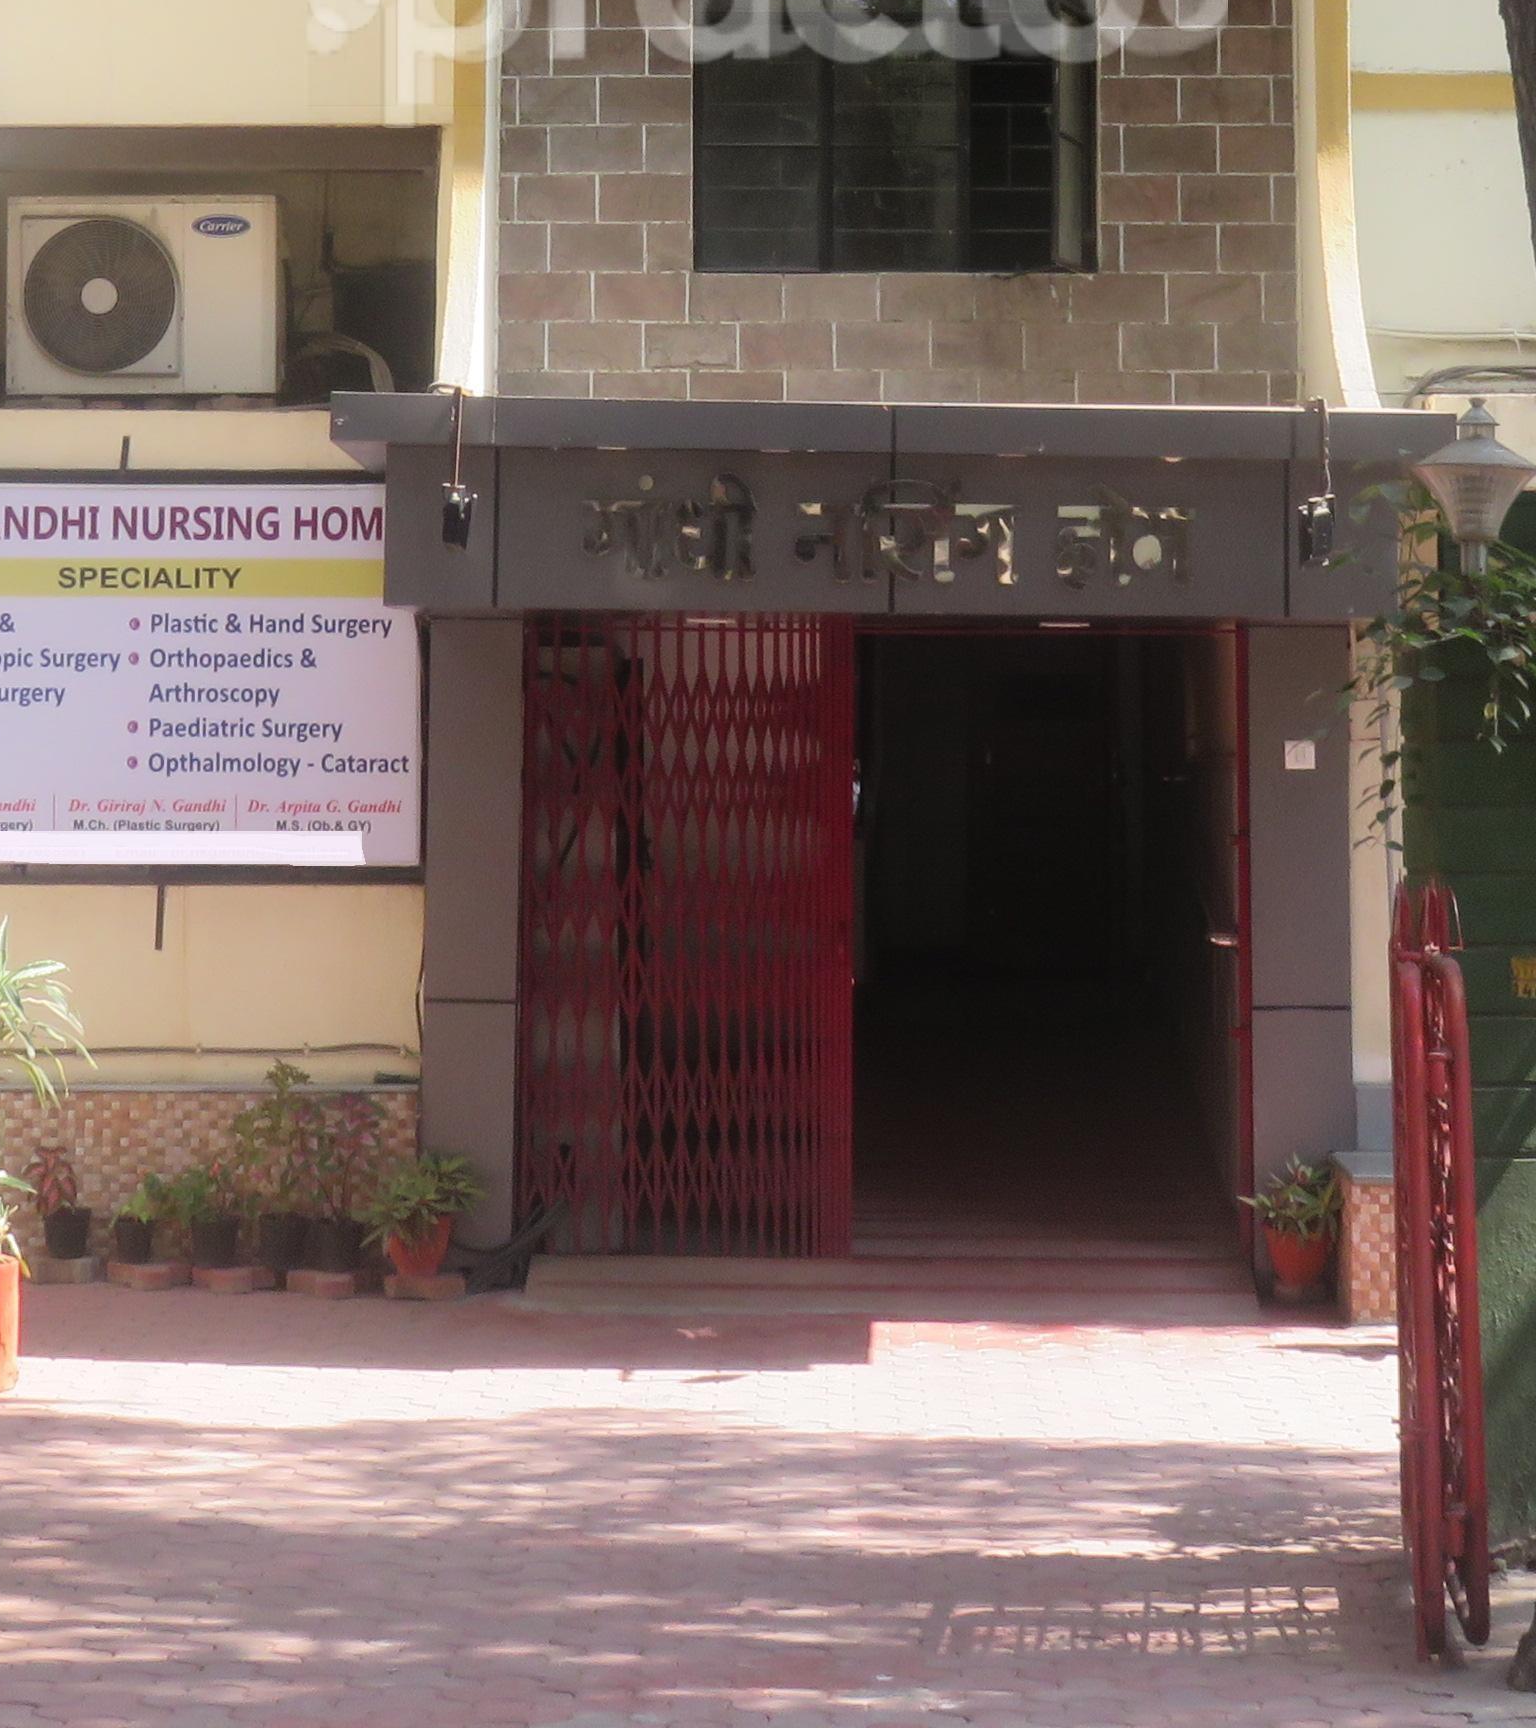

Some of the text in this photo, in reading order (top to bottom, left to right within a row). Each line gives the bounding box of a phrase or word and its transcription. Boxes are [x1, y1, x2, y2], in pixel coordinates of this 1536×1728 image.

[199, 219, 243, 234] Carrier
[112, 505, 280, 541] NURSING
[581, 472, 757, 583] गांधी
[1056, 482, 1197, 590] होम
[58, 567, 241, 589] SPECIALITY
[150, 613, 392, 638] Plastic & Hand Surgery
[40, 648, 121, 672] Surgery
[150, 648, 317, 672] Orthopaedics &
[148, 683, 280, 708] Arthroscopy
[149, 718, 343, 743] Paediatric Surgery
[148, 752, 301, 777] Opthalmology
[321, 753, 409, 774] Cataract
[68, 799, 90, 812] Dr.
[97, 798, 146, 815] Giriraj
[172, 799, 227, 813] Gandhi
[247, 799, 402, 816] Dr. Arpita G. Gandhi
[73, 819, 220, 831] M.Ch. (Plastic Surgery)
[276, 820, 304, 831] M.S.
[348, 820, 371, 833] GY)
